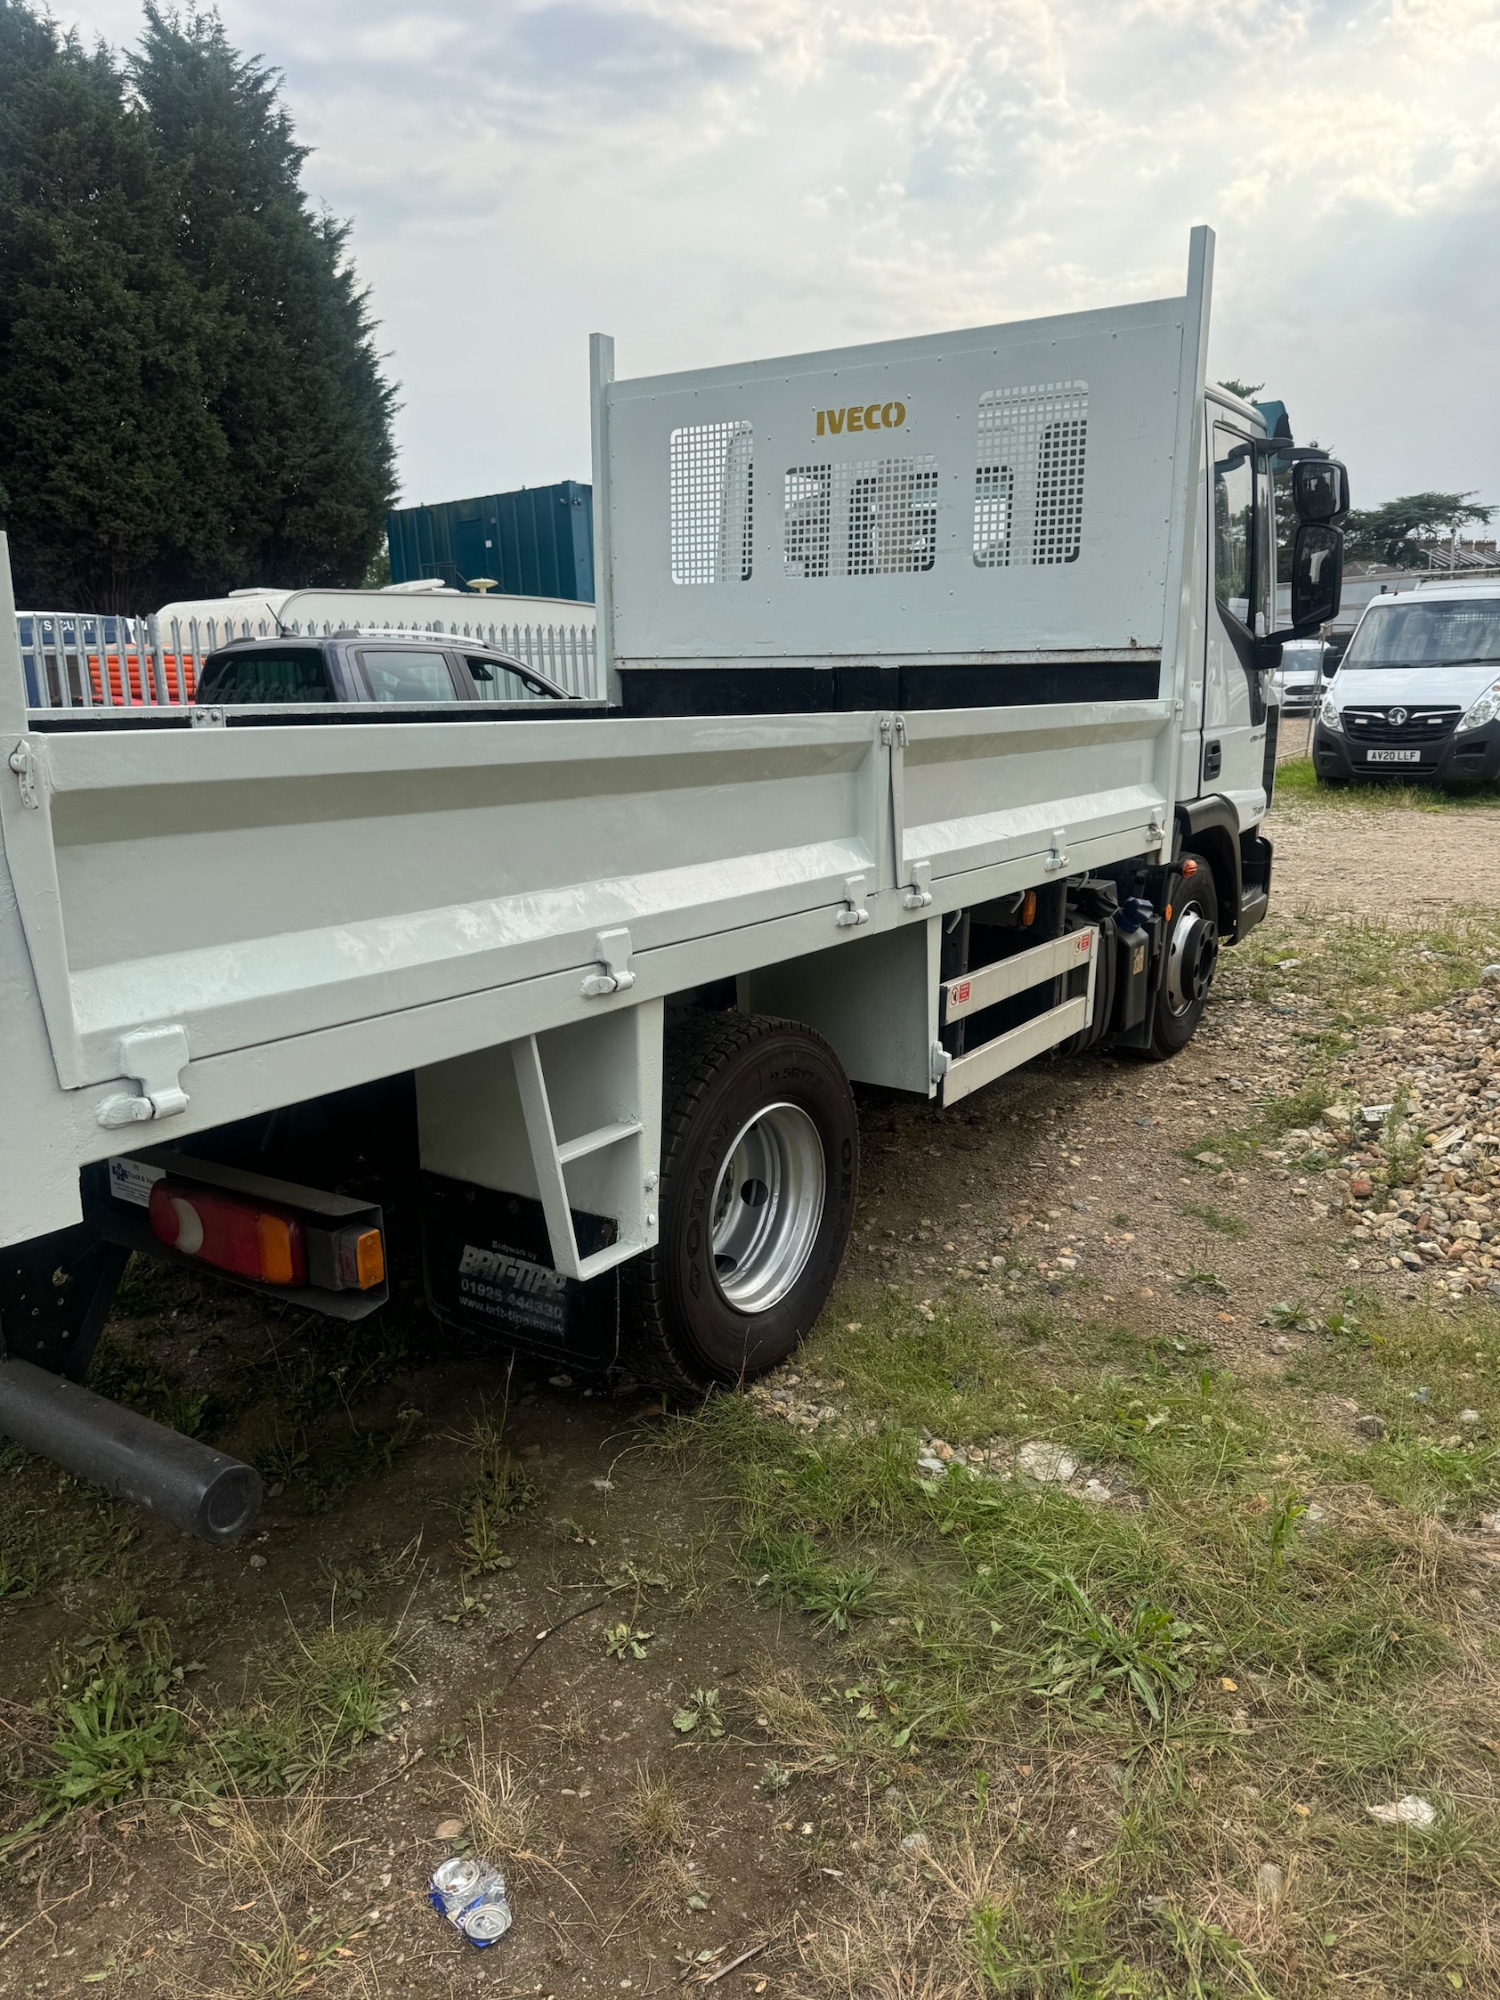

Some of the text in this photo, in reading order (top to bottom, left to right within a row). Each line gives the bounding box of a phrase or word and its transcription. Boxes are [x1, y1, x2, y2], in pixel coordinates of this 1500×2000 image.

[816, 401, 906, 436] IVECO
[1371, 751, 1396, 761] AV20
[687, 1113, 734, 1259] OTANI
[492, 1240, 527, 1257] Bodywork
[458, 1244, 568, 1298] BRIT-TIPP
[461, 1278, 503, 1303] 01925
